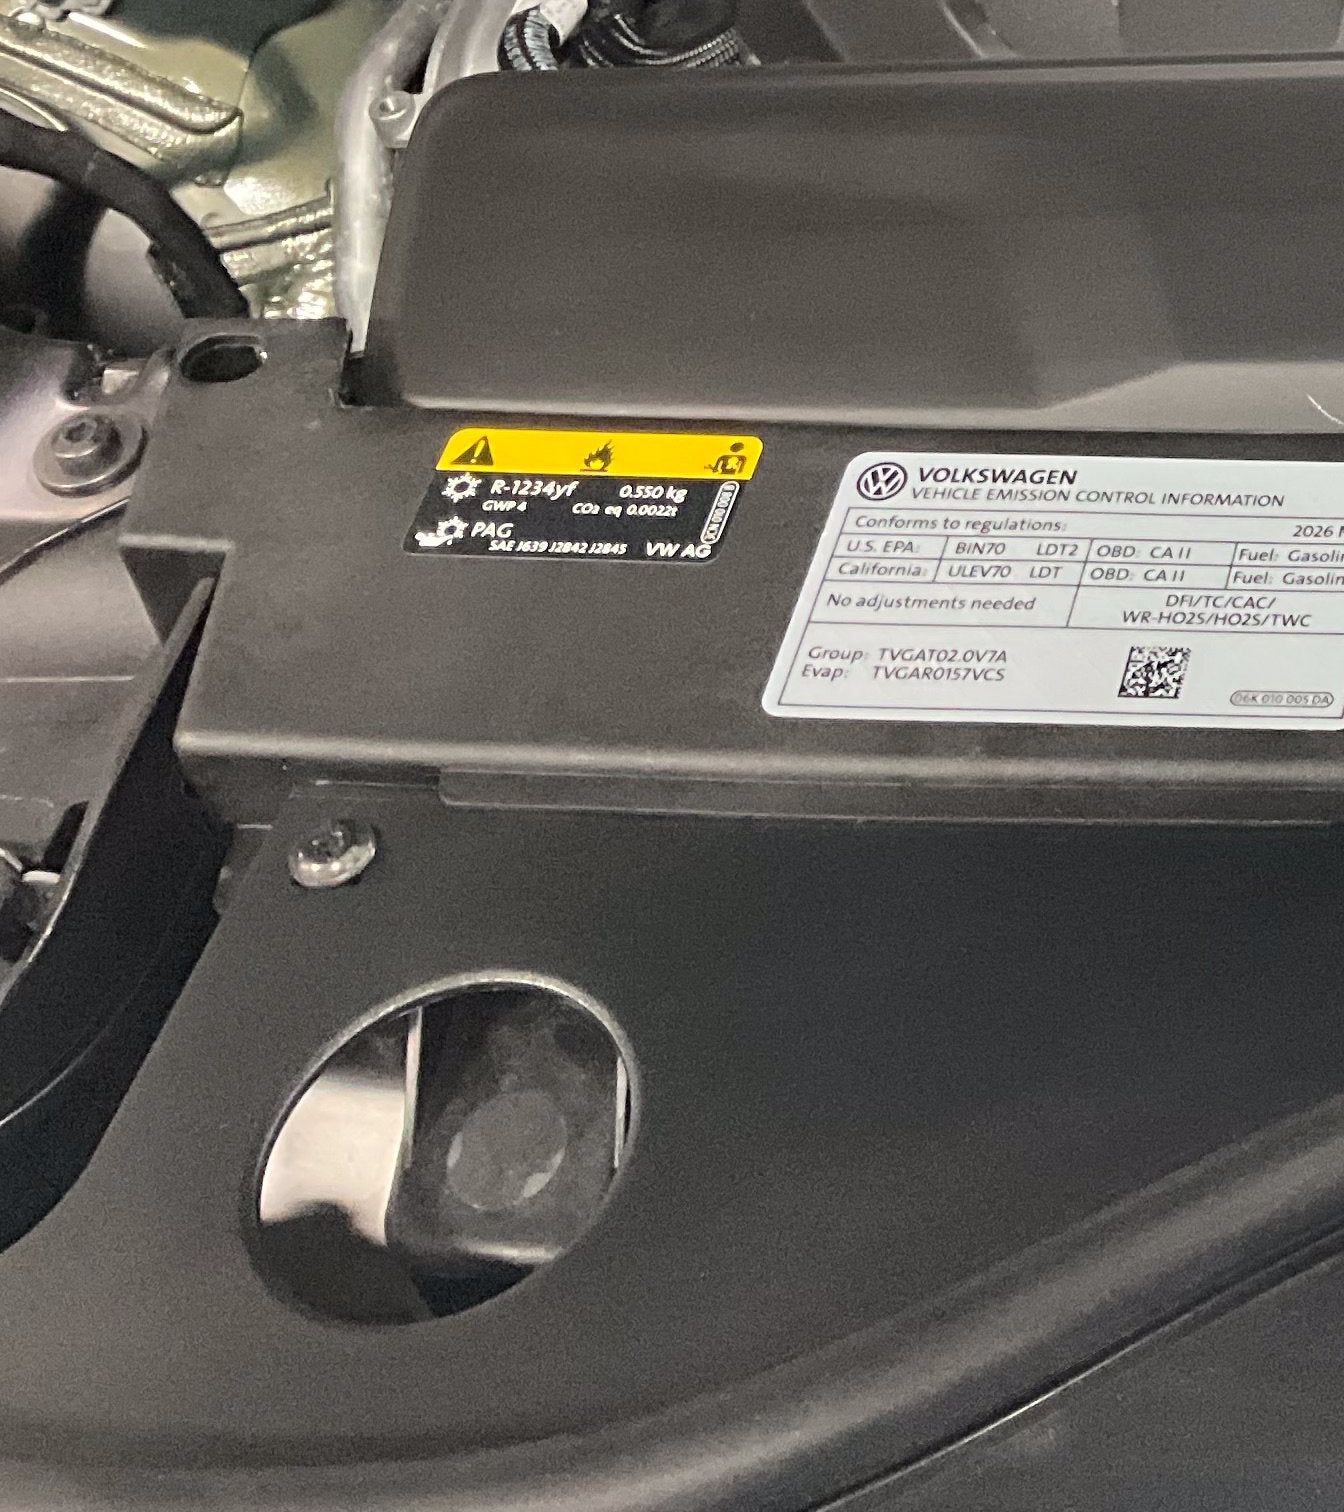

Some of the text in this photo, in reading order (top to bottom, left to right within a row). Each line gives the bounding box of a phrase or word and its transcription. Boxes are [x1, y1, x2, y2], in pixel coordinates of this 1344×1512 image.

[919, 467, 1079, 486] VOLKSWAGEN
[490, 478, 580, 498] R-1234yf
[619, 484, 689, 504] 0.550 kg
[912, 487, 1286, 508] VEHICLE EMISSION CONTROL INFORMATION
[481, 499, 517, 512] GWP
[470, 521, 515, 539] PAG
[855, 515, 939, 530] Conforms
[943, 517, 961, 531] to
[1292, 525, 1334, 538] 2026
[488, 539, 517, 552] SAE
[646, 541, 714, 559] VW AG
[955, 541, 1007, 556] BIN70
[1036, 543, 1079, 557] LDT2
[1149, 546, 1174, 559] CA
[948, 565, 1013, 579] ULEV70
[1029, 566, 1064, 579] LDT
[1143, 568, 1168, 582] CA
[826, 593, 1038, 612] No adjustments needed
